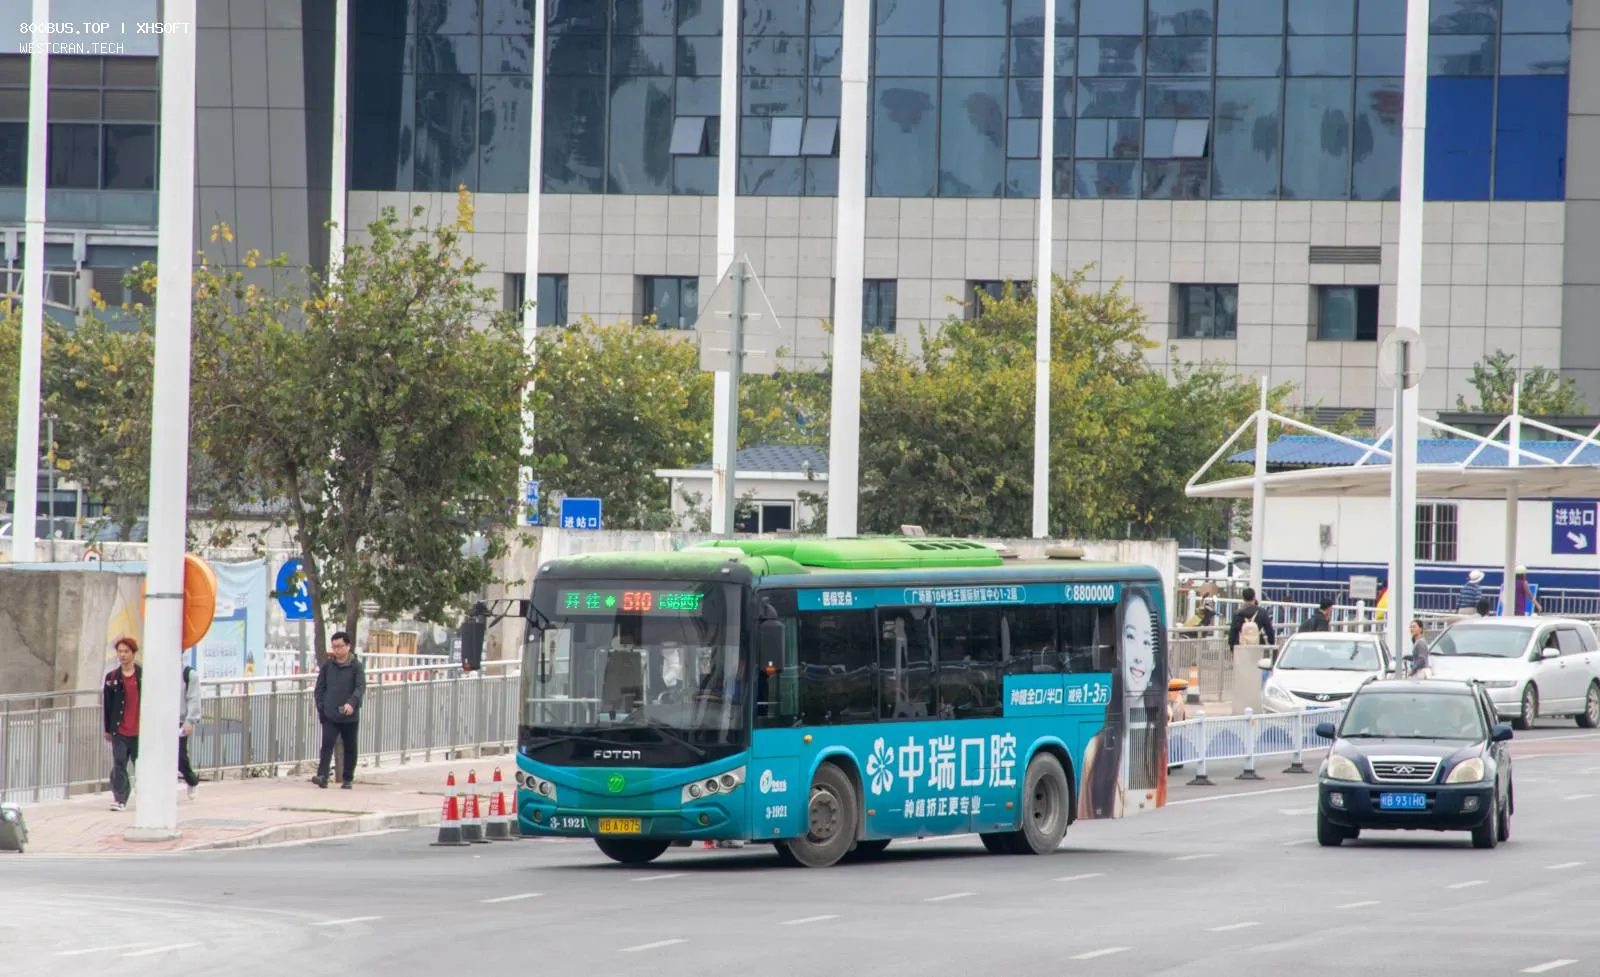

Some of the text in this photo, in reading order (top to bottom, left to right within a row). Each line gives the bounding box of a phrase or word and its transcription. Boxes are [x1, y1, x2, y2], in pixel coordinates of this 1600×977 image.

[1555, 507, 1595, 526] 进站口
[623, 591, 653, 612] 510
[1073, 584, 1115, 601] 8800000
[593, 750, 641, 759] FOTON
[898, 732, 1017, 794] 中瑞口腔
[904, 795, 981, 819] 种植矫正更专业
